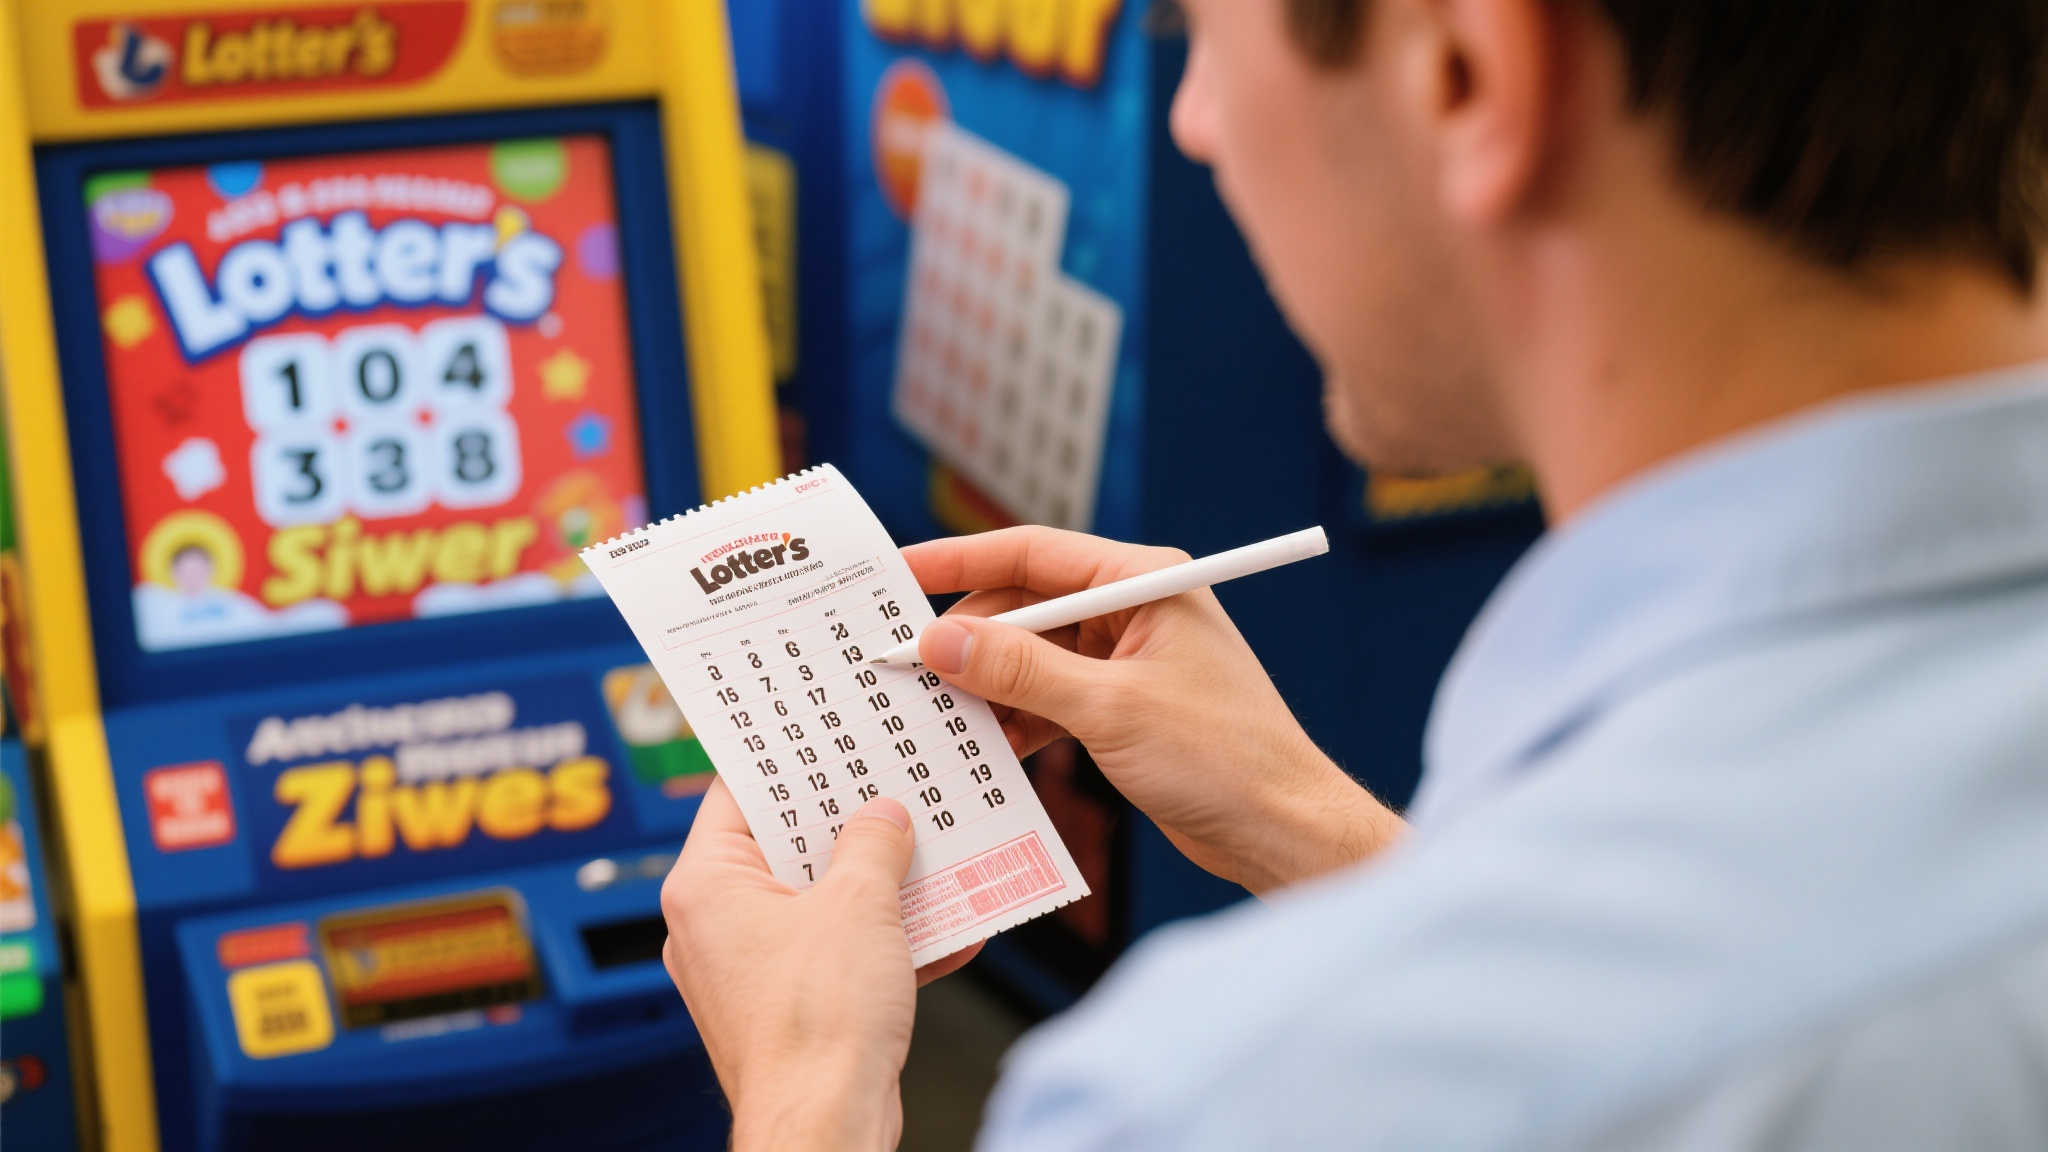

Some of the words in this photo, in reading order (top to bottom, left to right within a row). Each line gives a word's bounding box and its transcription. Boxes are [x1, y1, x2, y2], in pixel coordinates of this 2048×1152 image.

[147, 209, 563, 362] Lotter's
[275, 360, 303, 411] 1
[356, 347, 402, 405] 0
[442, 342, 486, 391] 4
[281, 446, 324, 503] 3
[452, 430, 496, 484] 8
[263, 515, 536, 606] Siwer
[690, 532, 809, 595] Lotter's
[785, 641, 801, 658] 6
[892, 624, 913, 643] 10
[730, 711, 753, 729] 12
[806, 687, 827, 706] 17
[855, 670, 877, 688] 10
[782, 723, 805, 742] 13
[819, 711, 842, 730] 18
[869, 692, 890, 711] 10
[918, 671, 941, 690] 18
[796, 746, 818, 766] 13
[882, 716, 904, 735] 10
[932, 693, 955, 713] 18
[768, 783, 790, 802] 15
[807, 772, 830, 792] 12
[895, 739, 916, 758] 10
[920, 787, 941, 806] 10
[970, 764, 992, 784] 19
[270, 755, 612, 870] Ziwes
[780, 809, 798, 828] 17
[803, 863, 815, 881] 7
[932, 811, 954, 830] 10
[983, 788, 1005, 808] 18
